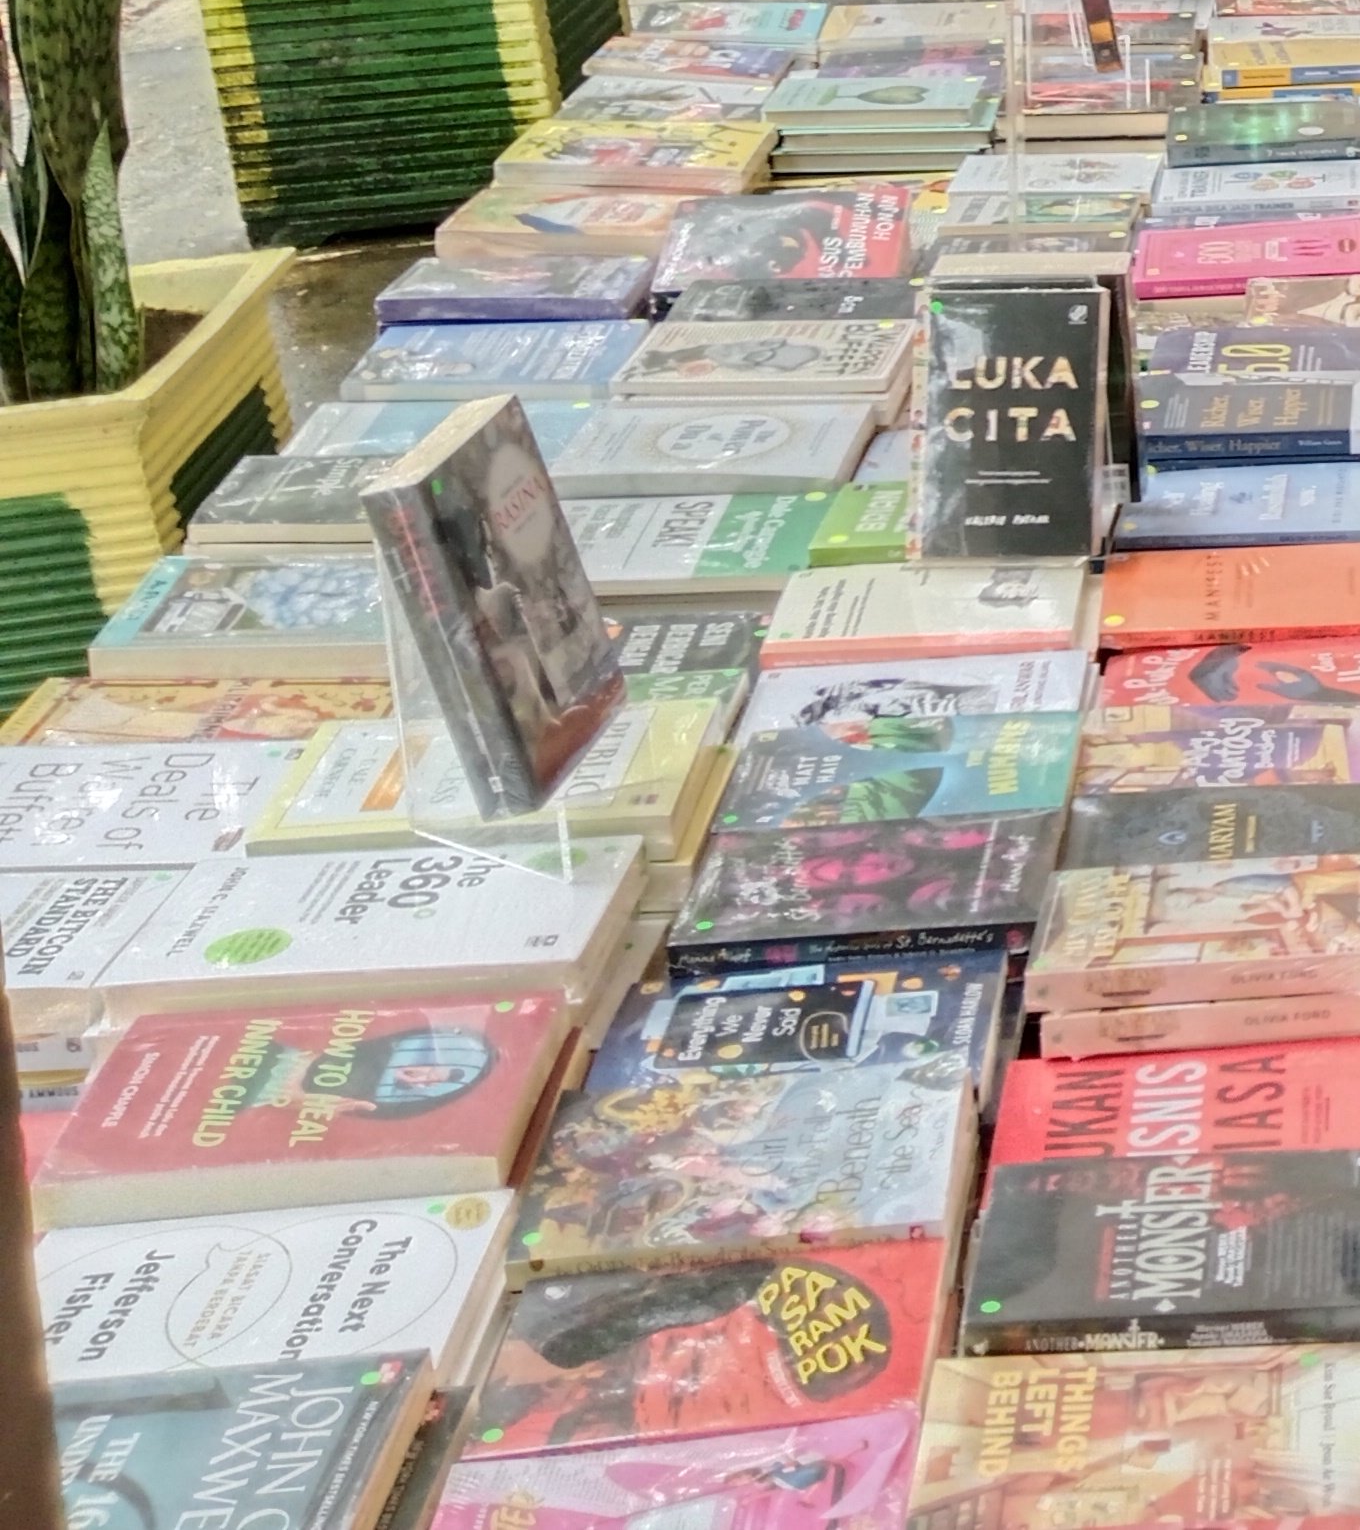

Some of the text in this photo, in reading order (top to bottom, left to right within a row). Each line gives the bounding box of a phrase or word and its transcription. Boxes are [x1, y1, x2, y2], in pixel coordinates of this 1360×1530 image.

[1253, 200, 1294, 212] TRAINER
[948, 356, 1078, 389] LUKA
[944, 407, 1077, 442] CITA
[1272, 388, 1309, 427] Happier
[1229, 438, 1282, 455] Happier
[651, 500, 716, 549] SPEAK!
[765, 495, 798, 518] Dale
[793, 756, 819, 787] MATT
[815, 754, 843, 783] HAIG
[987, 720, 1033, 796] HUMANS
[96, 752, 216, 851] Deals of
[5, 877, 99, 959] STANDARD
[333, 857, 410, 927] Leader
[17, 876, 129, 977] THE BITCOIN
[678, 996, 727, 1062] Everything
[715, 1014, 744, 1037] We
[741, 1005, 773, 1043] Never
[771, 1007, 802, 1037] Said
[951, 1016, 973, 1045] SLOAN
[1243, 1008, 1331, 1027] OLIVIA FORD
[191, 1018, 284, 1150] INNER CHILD
[288, 1008, 377, 1149] HOW TO HEAL
[1115, 1161, 1220, 1300] MONSTER
[44, 1271, 116, 1346] Fisher
[78, 1248, 176, 1363] Jefferson
[278, 1218, 379, 1361] Conversation
[338, 1234, 414, 1335] The Next
[758, 1266, 808, 1316] PA
[780, 1270, 837, 1332] SA
[789, 1287, 871, 1357] RAM
[1024, 1336, 1079, 1351] ANOTHER
[797, 1323, 887, 1385] POK
[979, 1365, 1017, 1478] BEHIND
[1020, 1366, 1060, 1437] LEFT
[1056, 1366, 1098, 1471] THINGS
[88, 1431, 143, 1483] THE
[253, 1385, 355, 1495] JOHN
